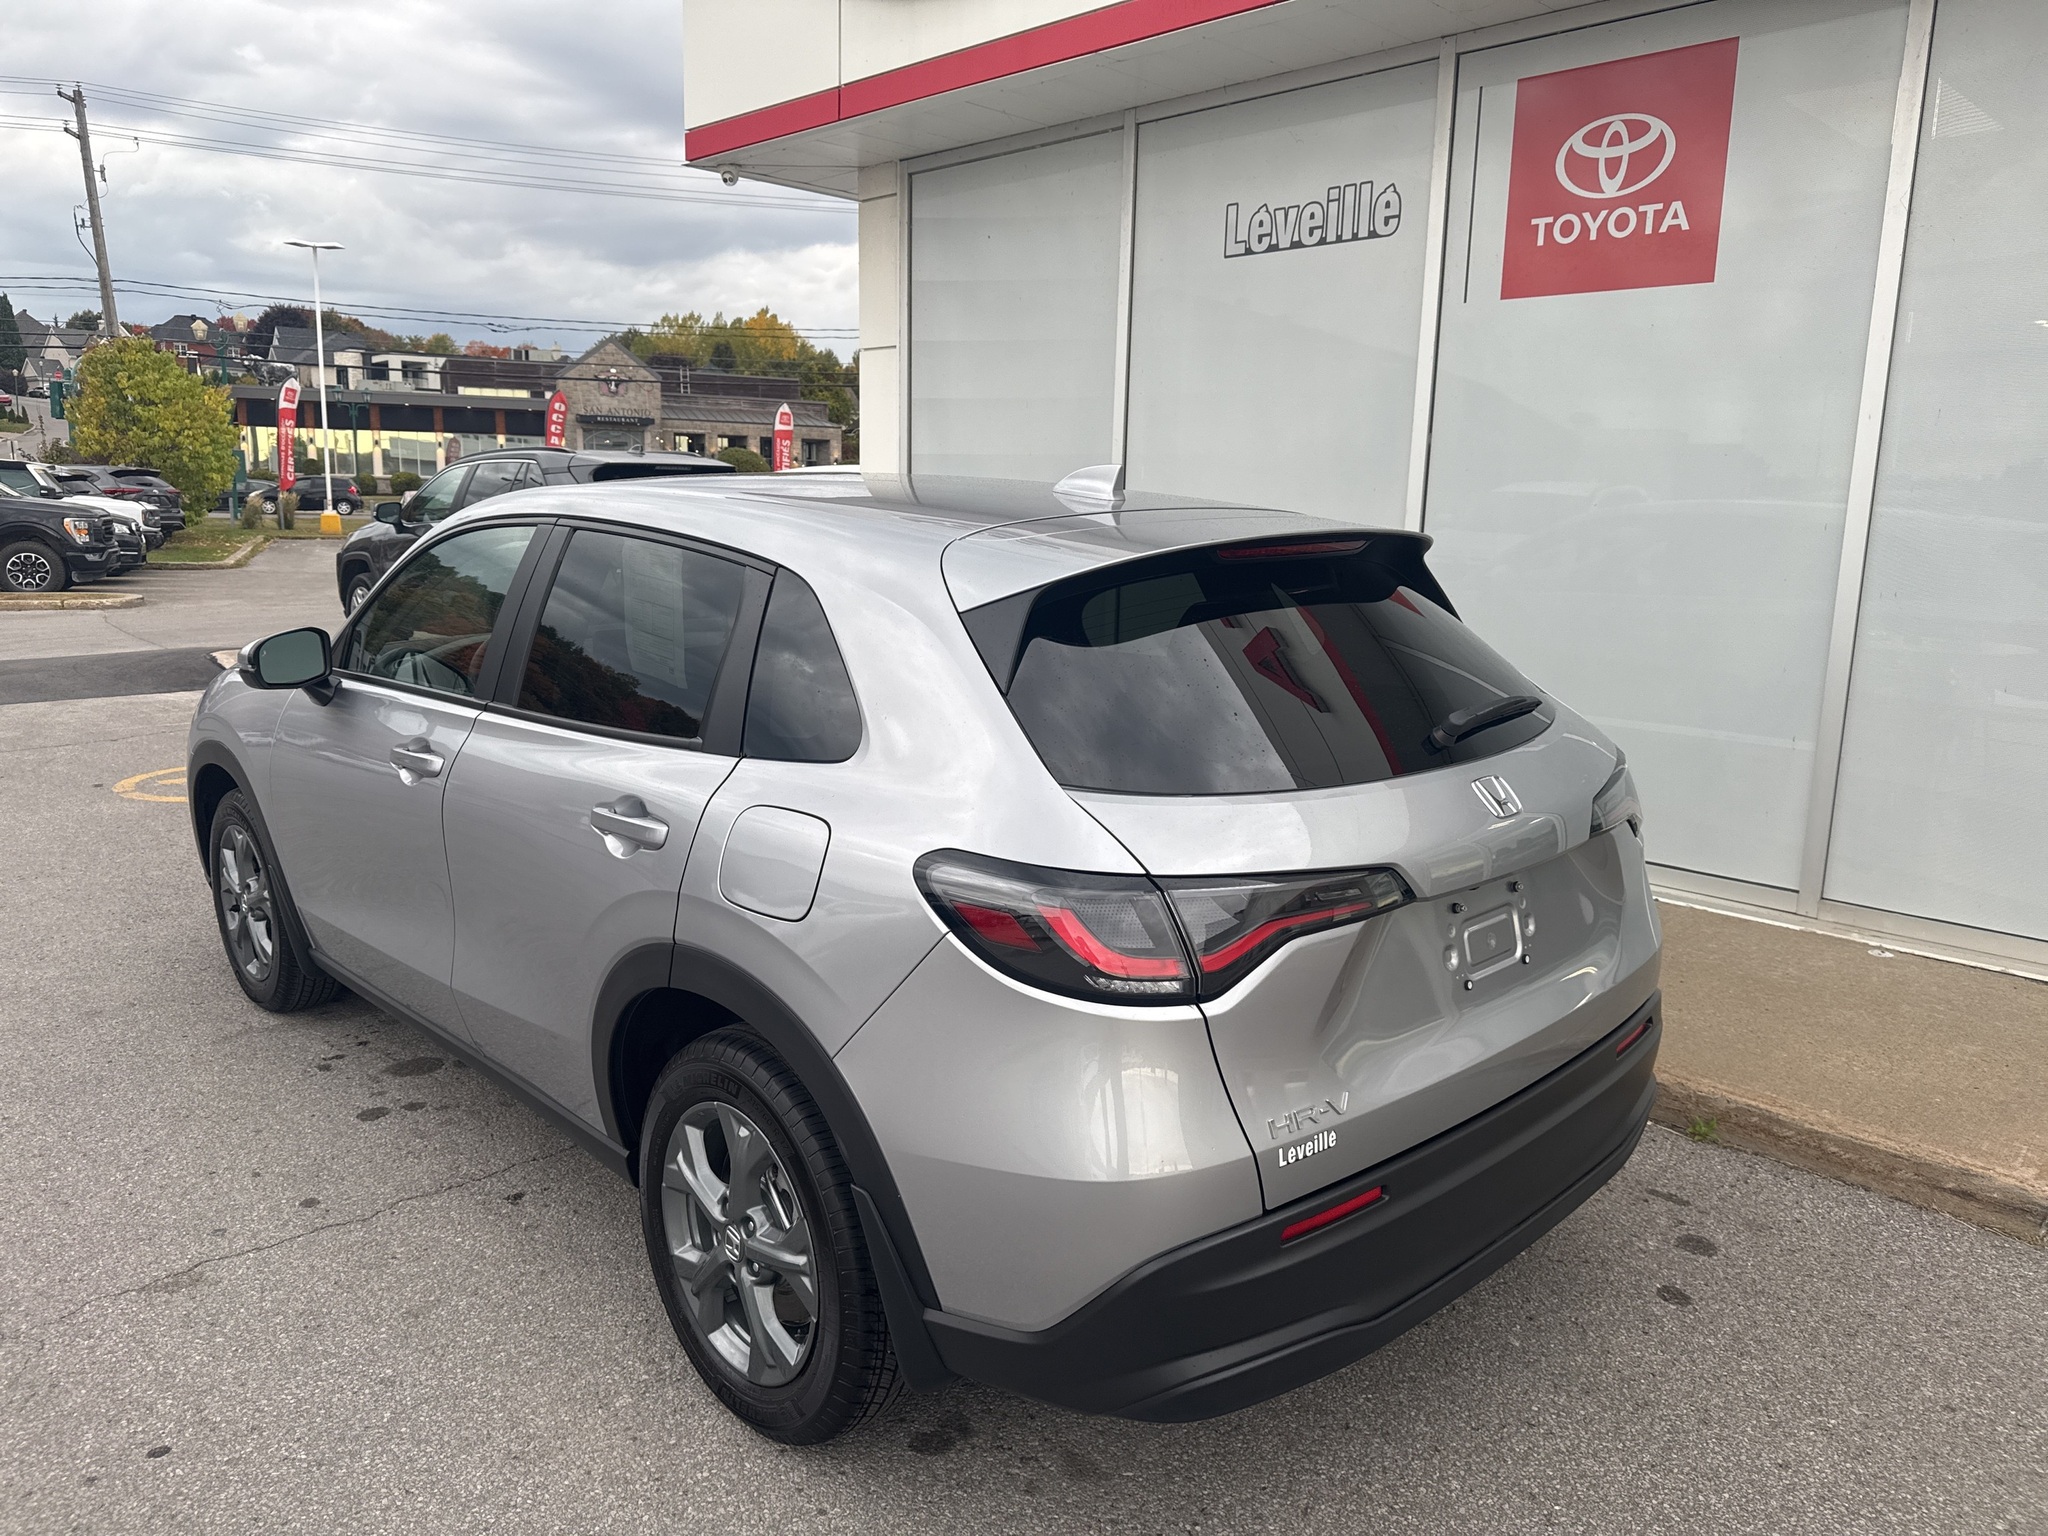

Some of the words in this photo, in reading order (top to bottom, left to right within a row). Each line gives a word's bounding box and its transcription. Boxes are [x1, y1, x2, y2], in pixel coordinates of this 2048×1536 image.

[1224, 181, 1402, 259] Léveillé
[1531, 200, 1690, 246] TOYOTA
[583, 405, 603, 416] SAN
[608, 407, 652, 417] ANTONIO
[683, 1071, 738, 1098] MICHELIN
[1267, 1091, 1348, 1140] HR-V
